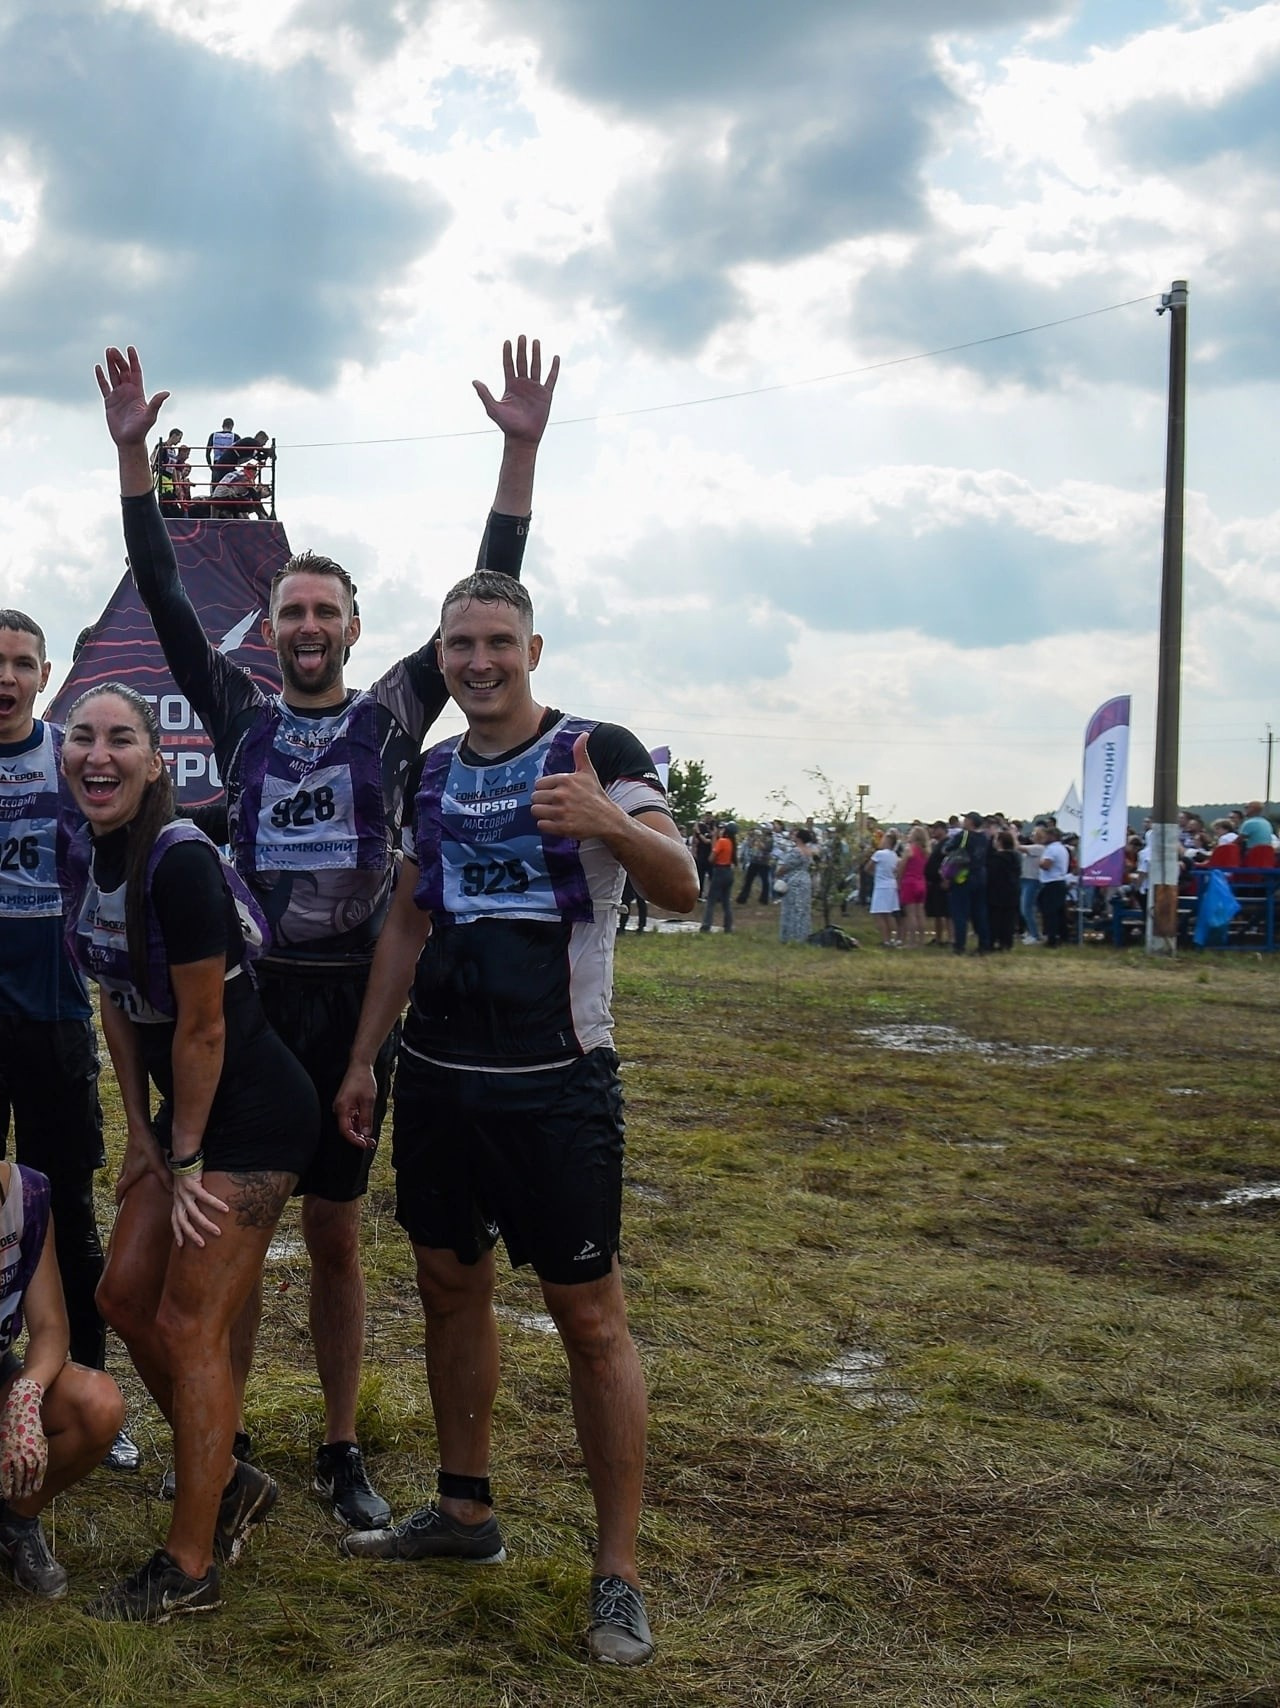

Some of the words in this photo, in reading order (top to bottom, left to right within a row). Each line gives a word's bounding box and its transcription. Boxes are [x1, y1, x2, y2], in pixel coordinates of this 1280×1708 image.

[9, 771, 44, 781] ГЕРОЕВ
[1100, 741, 1116, 817] АММОНИЙ
[455, 791, 486, 800] ГОНКА
[489, 781, 527, 797] ГЕРОЕВ
[270, 784, 336, 828] 928
[462, 809, 516, 830] МАССОВЫЙ
[474, 828, 503, 842] СТАРТ
[282, 840, 353, 852] АММОНИЙ
[462, 859, 531, 897] 925
